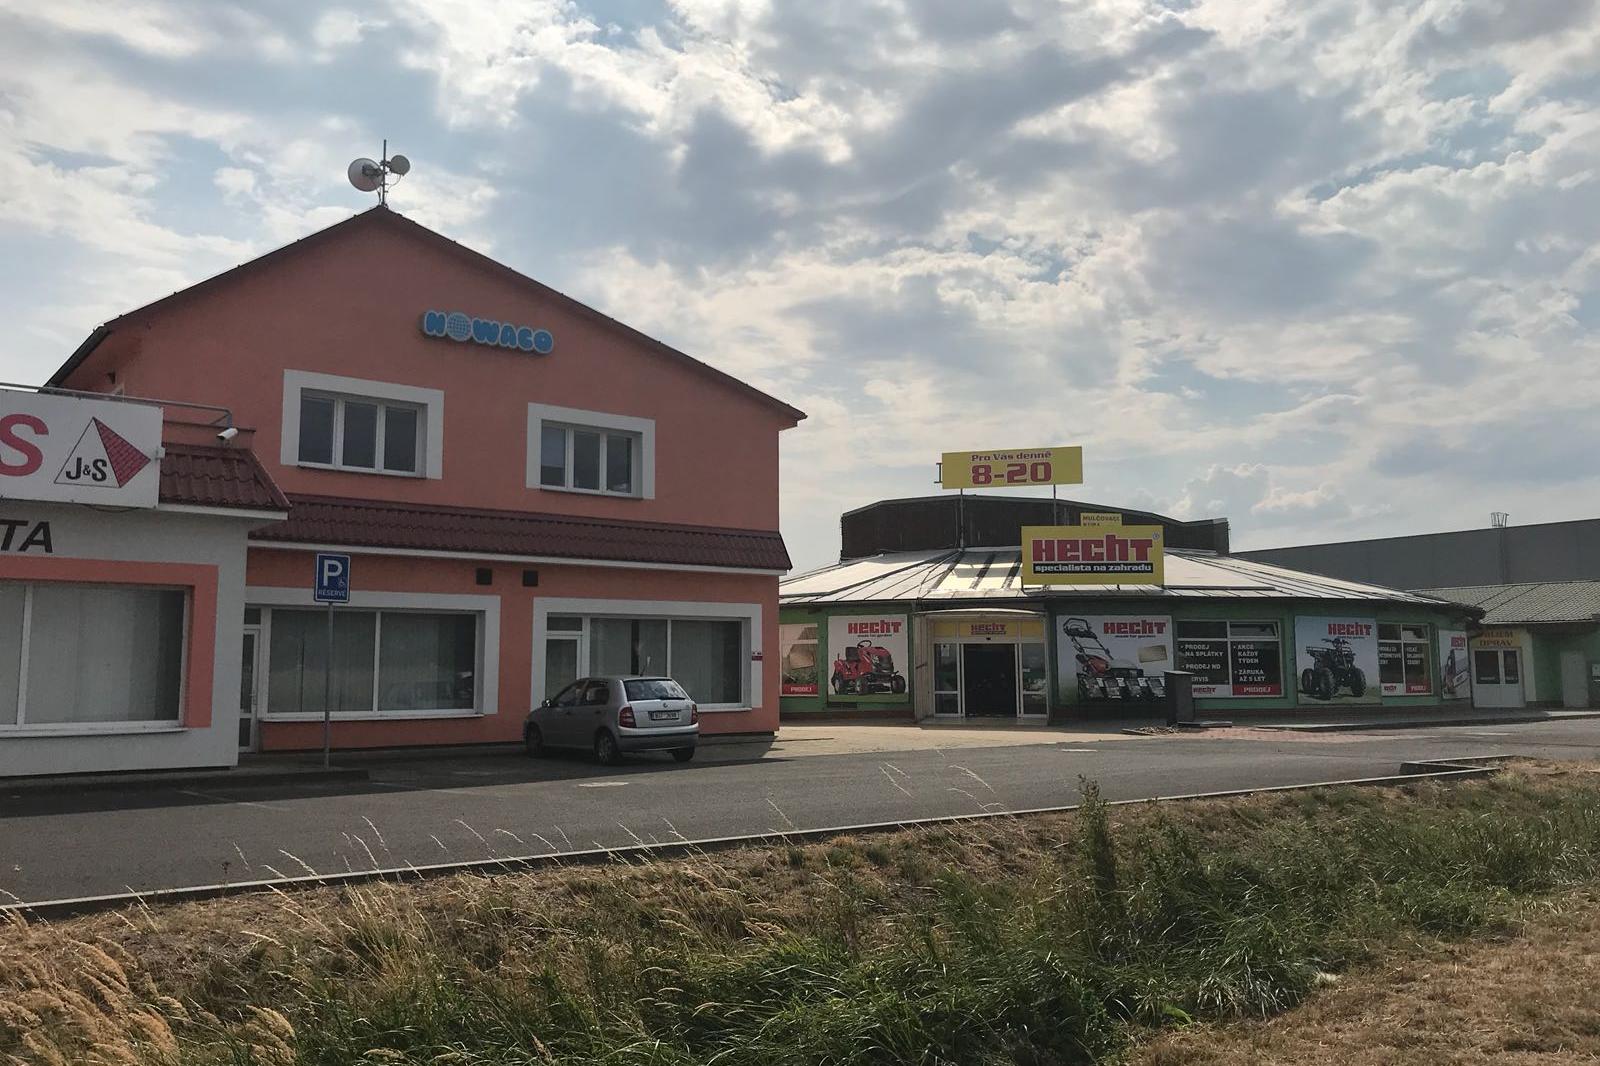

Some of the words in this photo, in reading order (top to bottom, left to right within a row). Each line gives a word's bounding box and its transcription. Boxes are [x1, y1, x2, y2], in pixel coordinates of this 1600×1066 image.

[971, 454, 990, 462] Pro
[993, 453, 1014, 461] Vás
[1016, 450, 1052, 460] denně
[65, 457, 107, 482] J&S
[971, 462, 1052, 485] 8-20
[323, 559, 342, 586] P
[1035, 563, 1091, 572] specialista
[1093, 564, 1106, 572] na
[1108, 563, 1152, 572] zahradu
